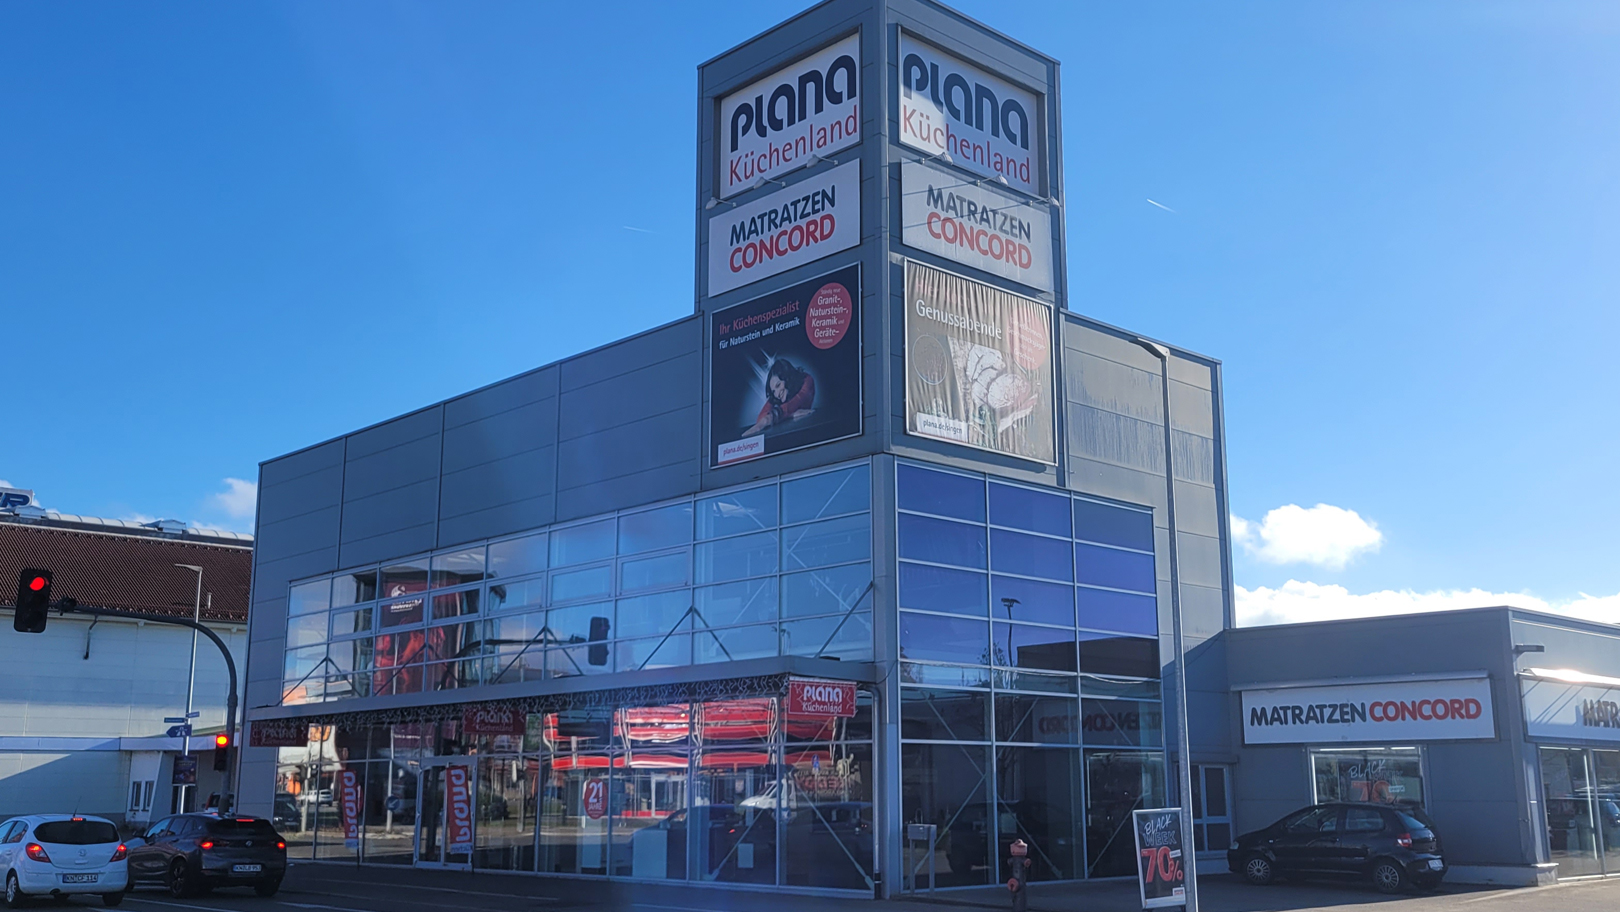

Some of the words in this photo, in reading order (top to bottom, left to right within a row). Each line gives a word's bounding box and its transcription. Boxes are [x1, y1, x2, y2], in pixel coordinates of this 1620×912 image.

[729, 105, 857, 187] Küchenland
[902, 104, 1030, 184] Küchenland
[729, 184, 836, 247] MATRATZEN
[926, 184, 1032, 244] MATRATZEN
[729, 213, 836, 273] CONCORD
[926, 211, 1032, 270] CONCORD
[719, 323, 731, 336] Ihr
[732, 300, 800, 332] Küchenspezialist
[719, 340, 729, 350] für
[729, 331, 761, 347] Naturstein
[762, 326, 774, 337] und
[775, 317, 800, 333] Keramik
[811, 316, 838, 328] Keramik
[814, 327, 840, 338] Geräte-
[916, 299, 1002, 340] Genussabende
[923, 419, 963, 435] plana.de/singen
[723, 442, 759, 456] plana.de/singen
[802, 701, 843, 713] Küchenland
[1250, 702, 1367, 727] MATRATZEN
[1369, 698, 1482, 722] CONCORD
[1348, 759, 1387, 779] BLACK
[589, 781, 603, 803] 21
[1143, 830, 1177, 847] WEEK
[1144, 814, 1172, 835] BLACK
[1141, 846, 1183, 883] 70%
